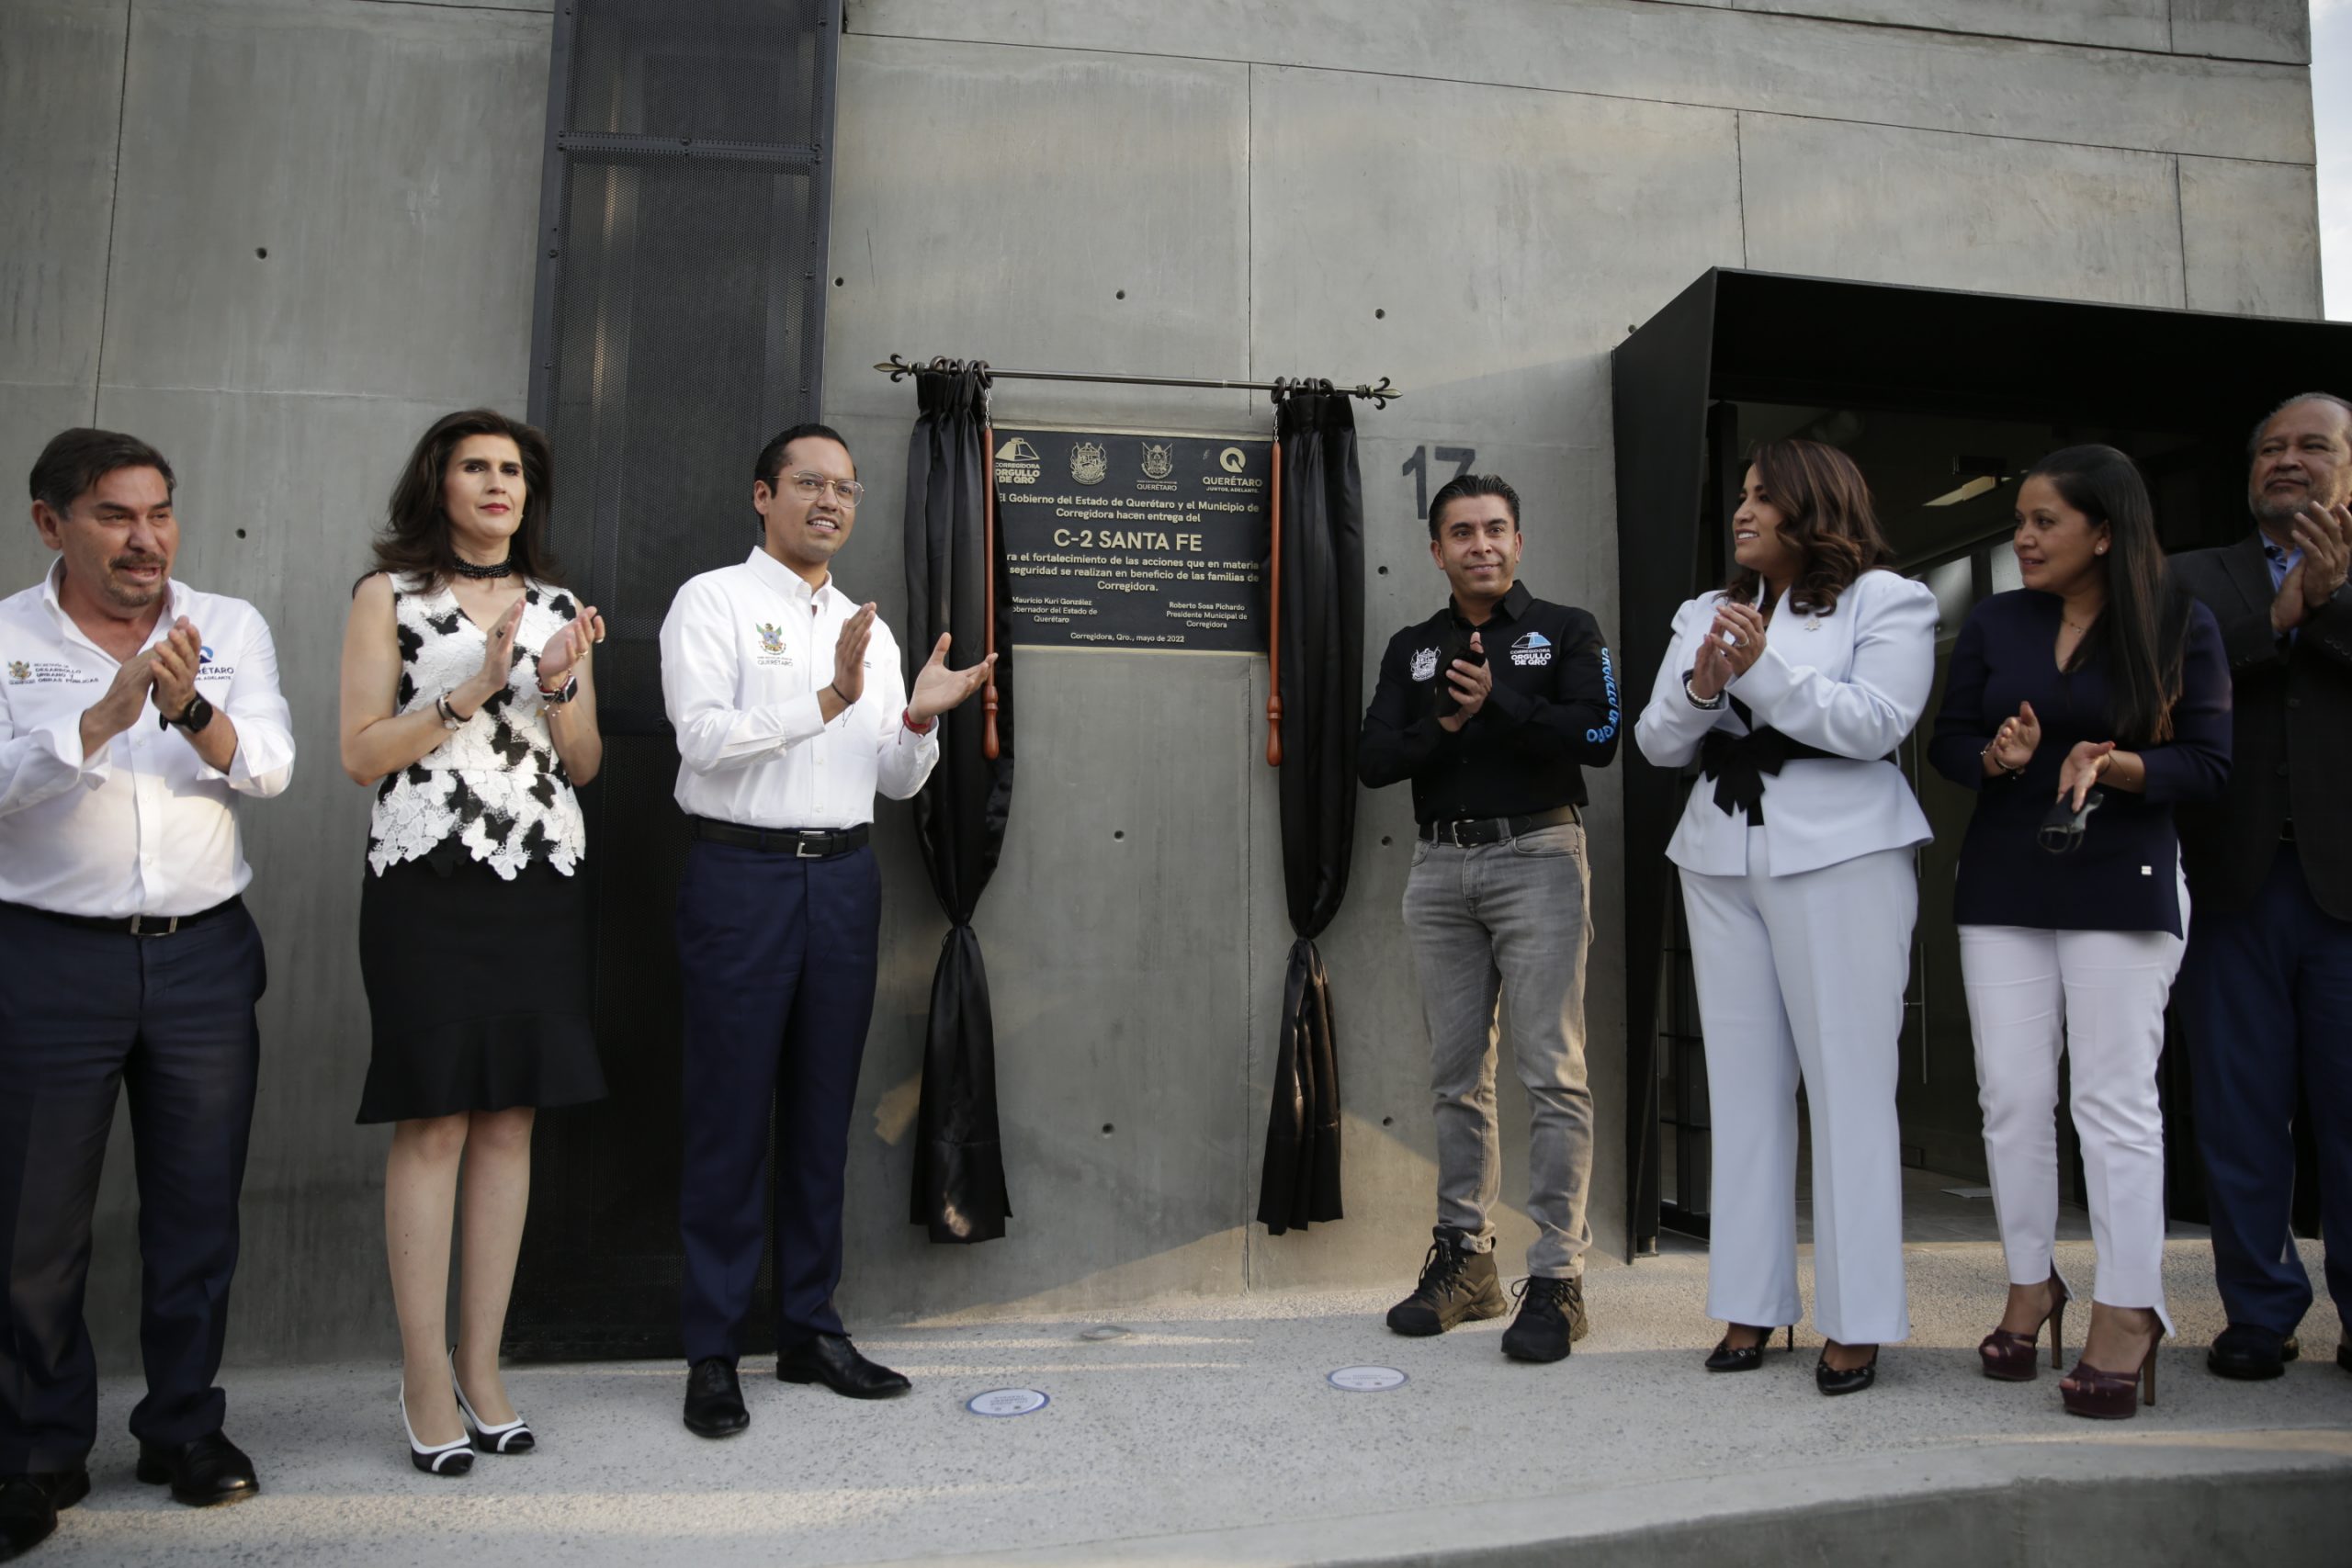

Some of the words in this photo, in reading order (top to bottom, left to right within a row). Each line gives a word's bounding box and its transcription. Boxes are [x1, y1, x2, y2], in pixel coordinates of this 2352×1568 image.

[996, 468, 1040, 478] ORGULLO
[1203, 476, 1262, 487] QUERÉTARO
[1402, 445, 1476, 520] 17
[1009, 493, 1055, 504] Gobierno
[1057, 496, 1072, 505] del
[1075, 497, 1109, 506] Estado
[1111, 498, 1124, 507] de
[1125, 498, 1175, 509] Querétaro
[1177, 502, 1184, 511] y
[1186, 501, 1195, 509] el
[1198, 501, 1245, 513] Municipio
[1247, 503, 1260, 513] de
[1056, 508, 1114, 520] Corregidora
[1116, 511, 1145, 520] hacen
[1147, 513, 1184, 524] entrega
[1186, 513, 1201, 523] del
[1053, 528, 1093, 547] C-2
[1099, 530, 1170, 550] SANTA
[1176, 533, 1203, 552] FE
[1020, 553, 1030, 562] el
[1032, 552, 1107, 565] fortalecimiento
[1110, 556, 1122, 565] de
[1125, 556, 1139, 566] las
[1142, 558, 1184, 567] acciones
[1186, 560, 1205, 570] que
[1222, 560, 1260, 570] materia
[1009, 565, 1057, 577] seguridad
[1060, 568, 1071, 576] se
[1074, 567, 1113, 577] realizan
[1114, 570, 1127, 578] en
[1130, 570, 1174, 580] beneficio
[1176, 571, 1189, 580] de
[1192, 570, 1205, 581] las
[1207, 571, 1245, 582] familias
[1247, 573, 1260, 582] de
[1097, 581, 1159, 592] Corregidora.
[1012, 596, 1043, 604] Mauricio
[1063, 607, 1088, 615] Estado
[1169, 602, 1197, 610] Roberto
[1215, 603, 1246, 611] Pichardo
[1034, 615, 1069, 624] Querétaro
[1166, 610, 1203, 619] Presidente
[1204, 612, 1238, 621] Municipal
[1186, 620, 1227, 629] Corregidora
[1070, 632, 1115, 641] Corregidora,
[1136, 635, 1156, 643] mayo
[1167, 635, 1185, 643] 2022
[1510, 652, 1552, 660] ORGULLO
[198, 665, 234, 675] ÉTARO
